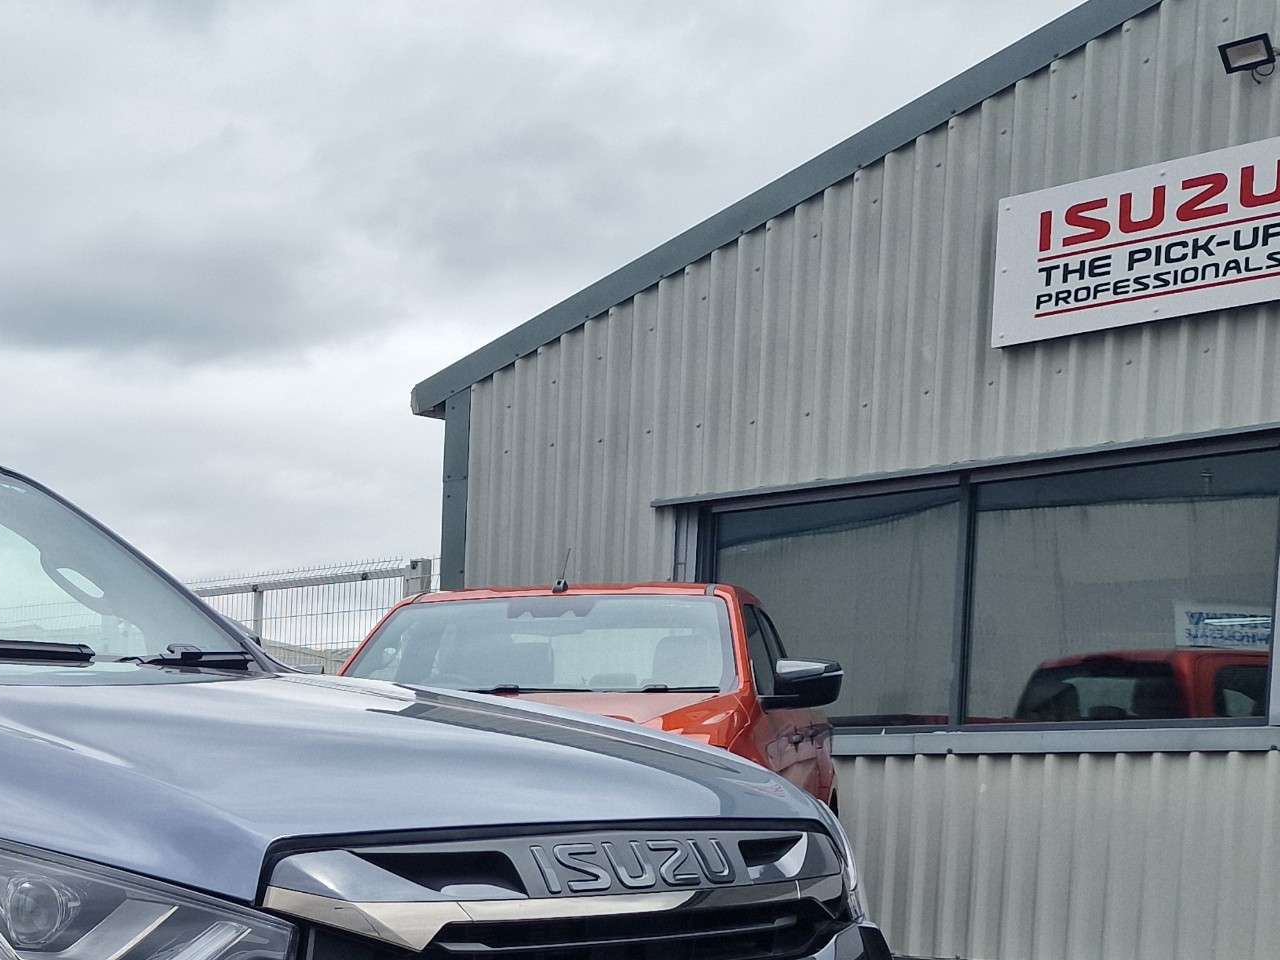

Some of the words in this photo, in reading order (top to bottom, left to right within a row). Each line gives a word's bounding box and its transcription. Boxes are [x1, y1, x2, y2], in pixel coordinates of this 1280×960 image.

[1039, 159, 1280, 252] ISUZU
[1038, 254, 1112, 287] THE
[528, 838, 737, 894] ISUZU
